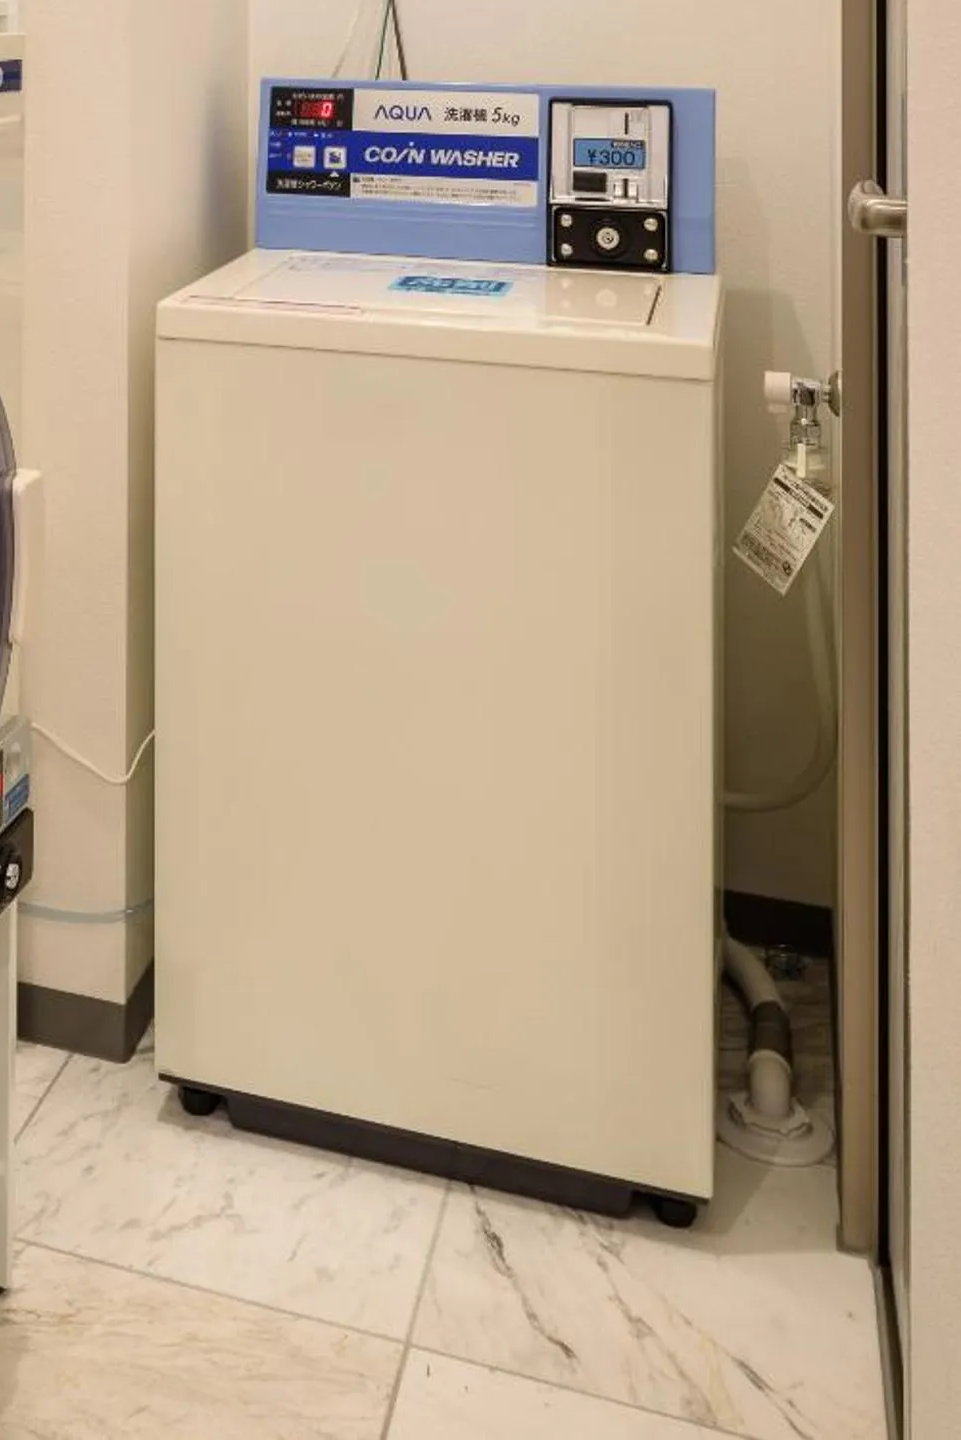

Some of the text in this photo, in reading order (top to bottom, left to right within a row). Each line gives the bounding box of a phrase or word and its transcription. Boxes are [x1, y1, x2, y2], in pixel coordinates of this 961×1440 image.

[373, 104, 432, 122] AQUA
[491, 106, 521, 127] 5kg
[430, 149, 520, 169] WASHER
[587, 148, 636, 166] ¥300
